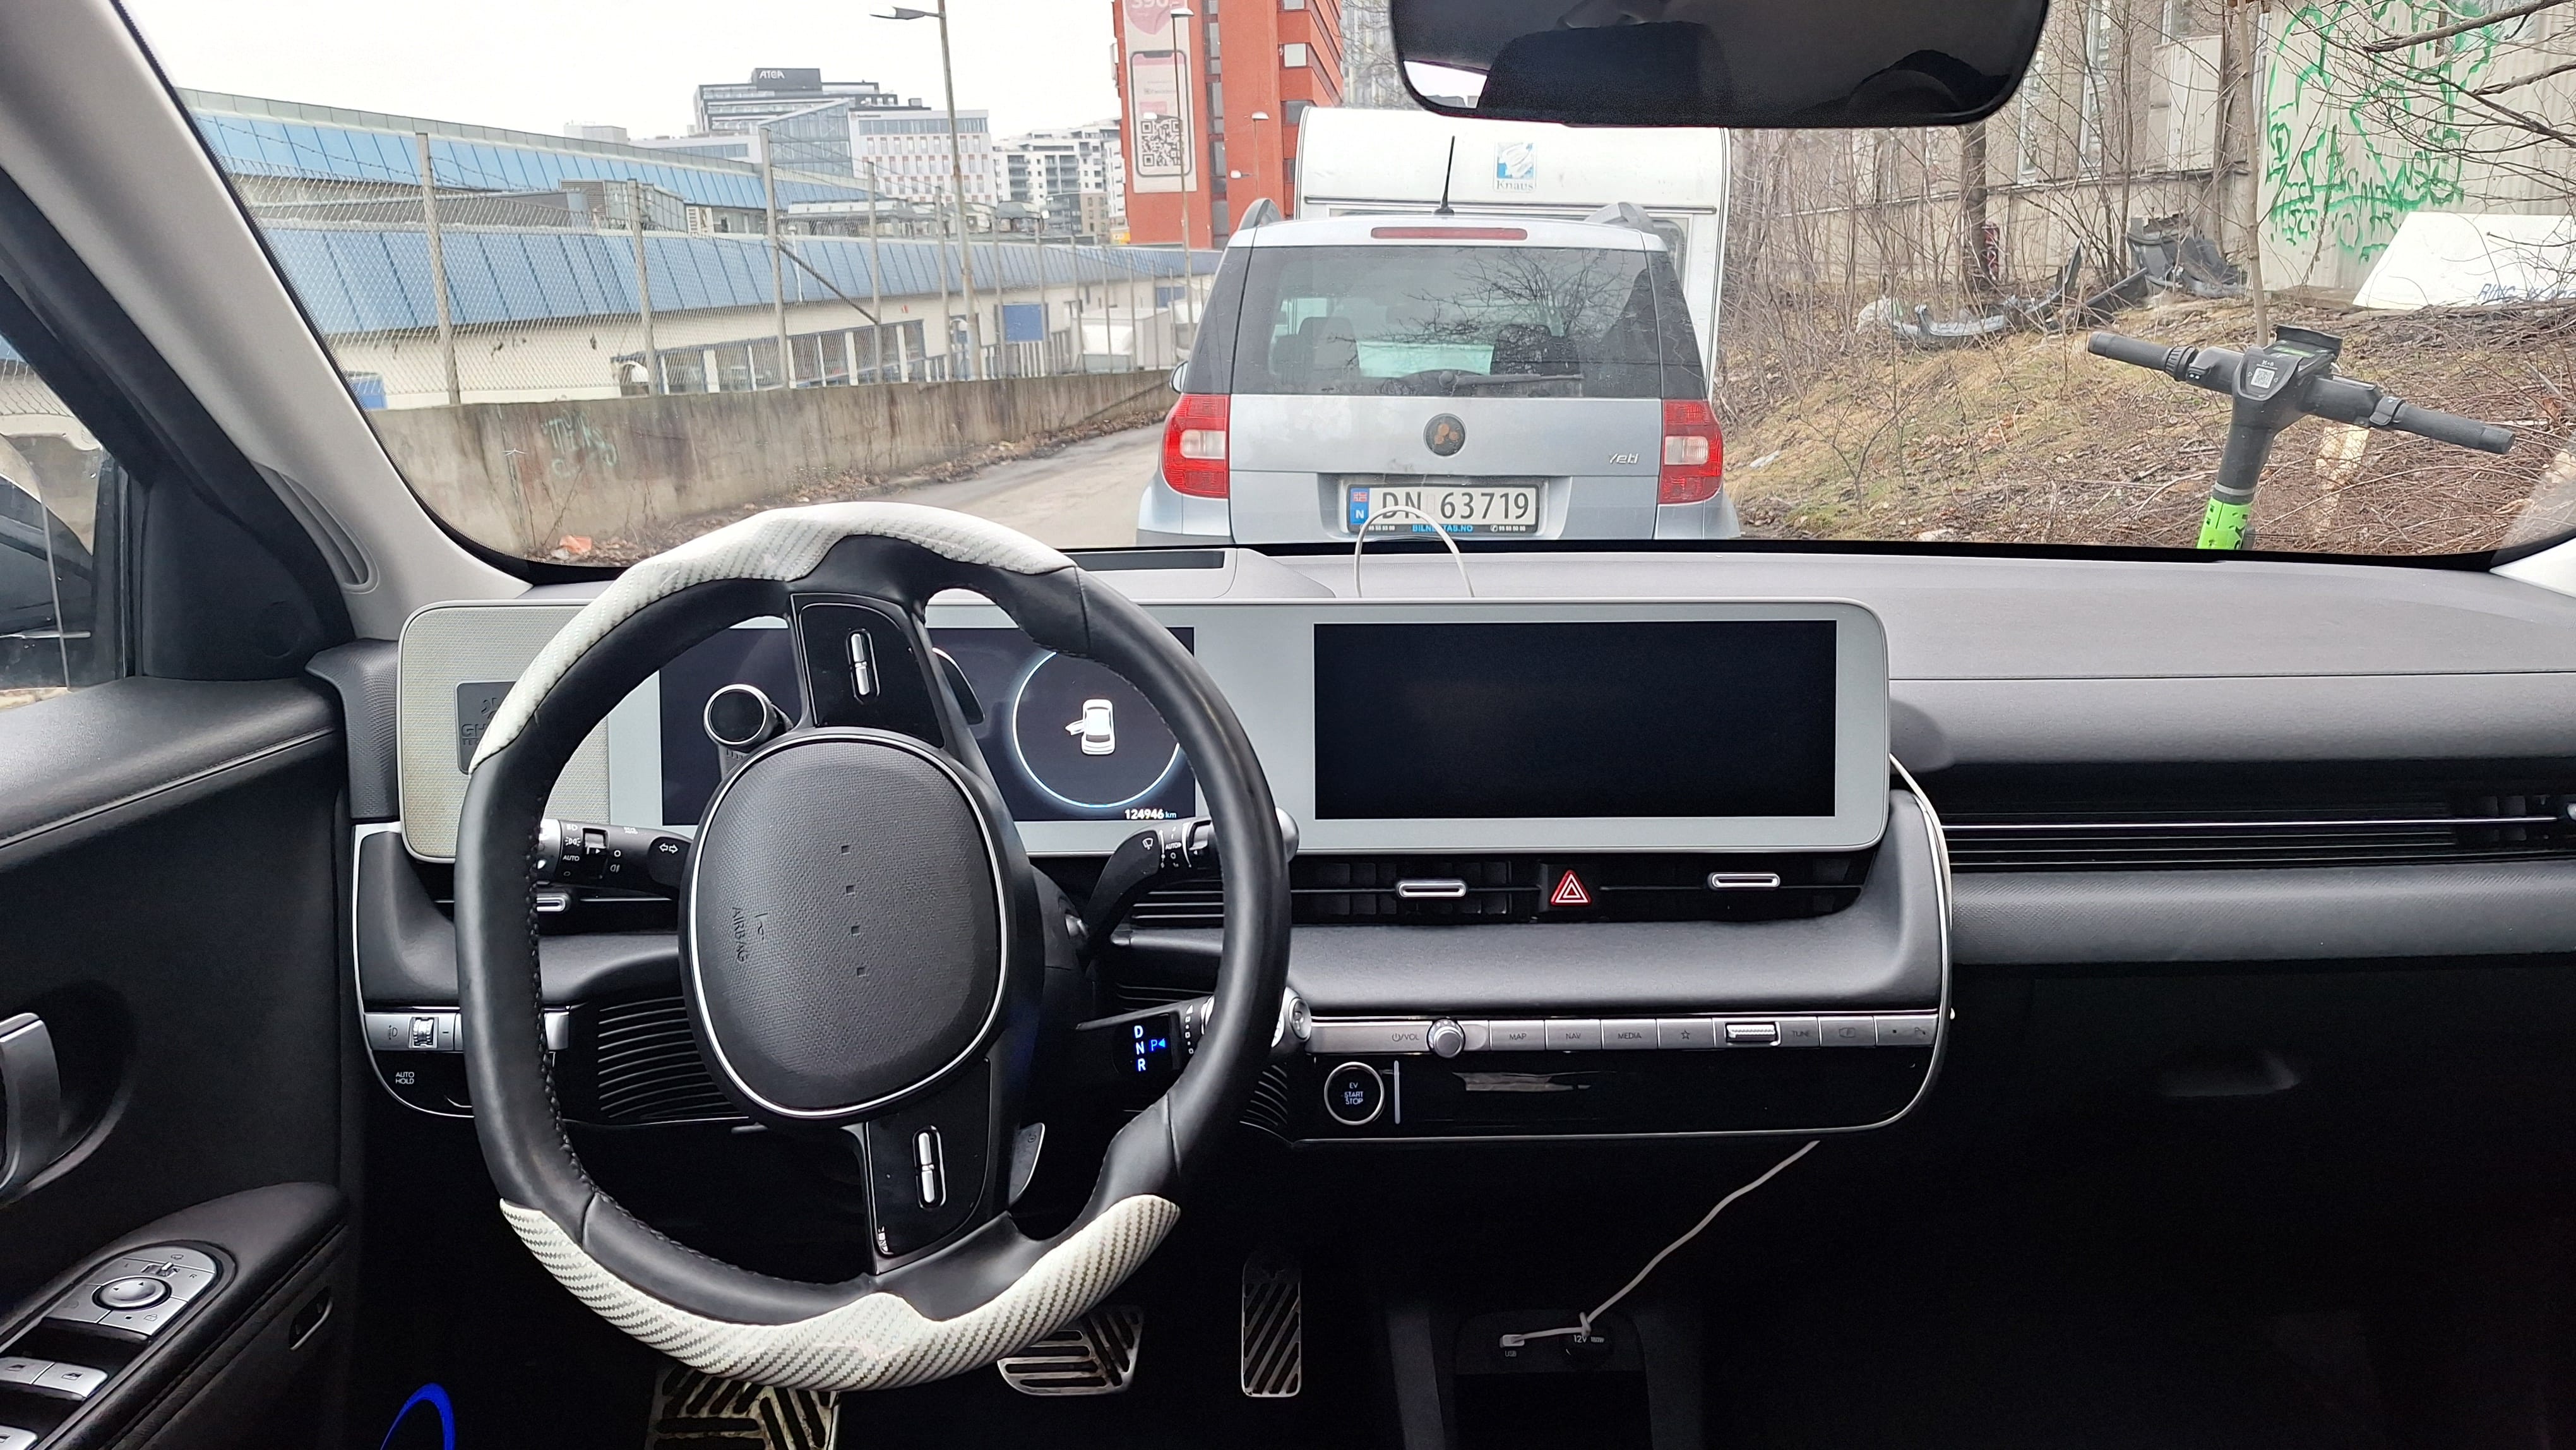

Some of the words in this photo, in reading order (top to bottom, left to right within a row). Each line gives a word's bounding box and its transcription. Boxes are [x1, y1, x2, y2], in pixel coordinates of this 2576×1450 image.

[1497, 180, 1533, 190] Knaus
[1383, 491, 1421, 519] DN
[1440, 492, 1529, 520] 63719
[1356, 510, 1364, 519] N
[1124, 809, 1164, 819] 124946
[1134, 1025, 1143, 1039] D
[1136, 1041, 1145, 1055] N
[1150, 1039, 1157, 1052] P
[1138, 1058, 1146, 1072] R
[1573, 1334, 1587, 1343] 12V
